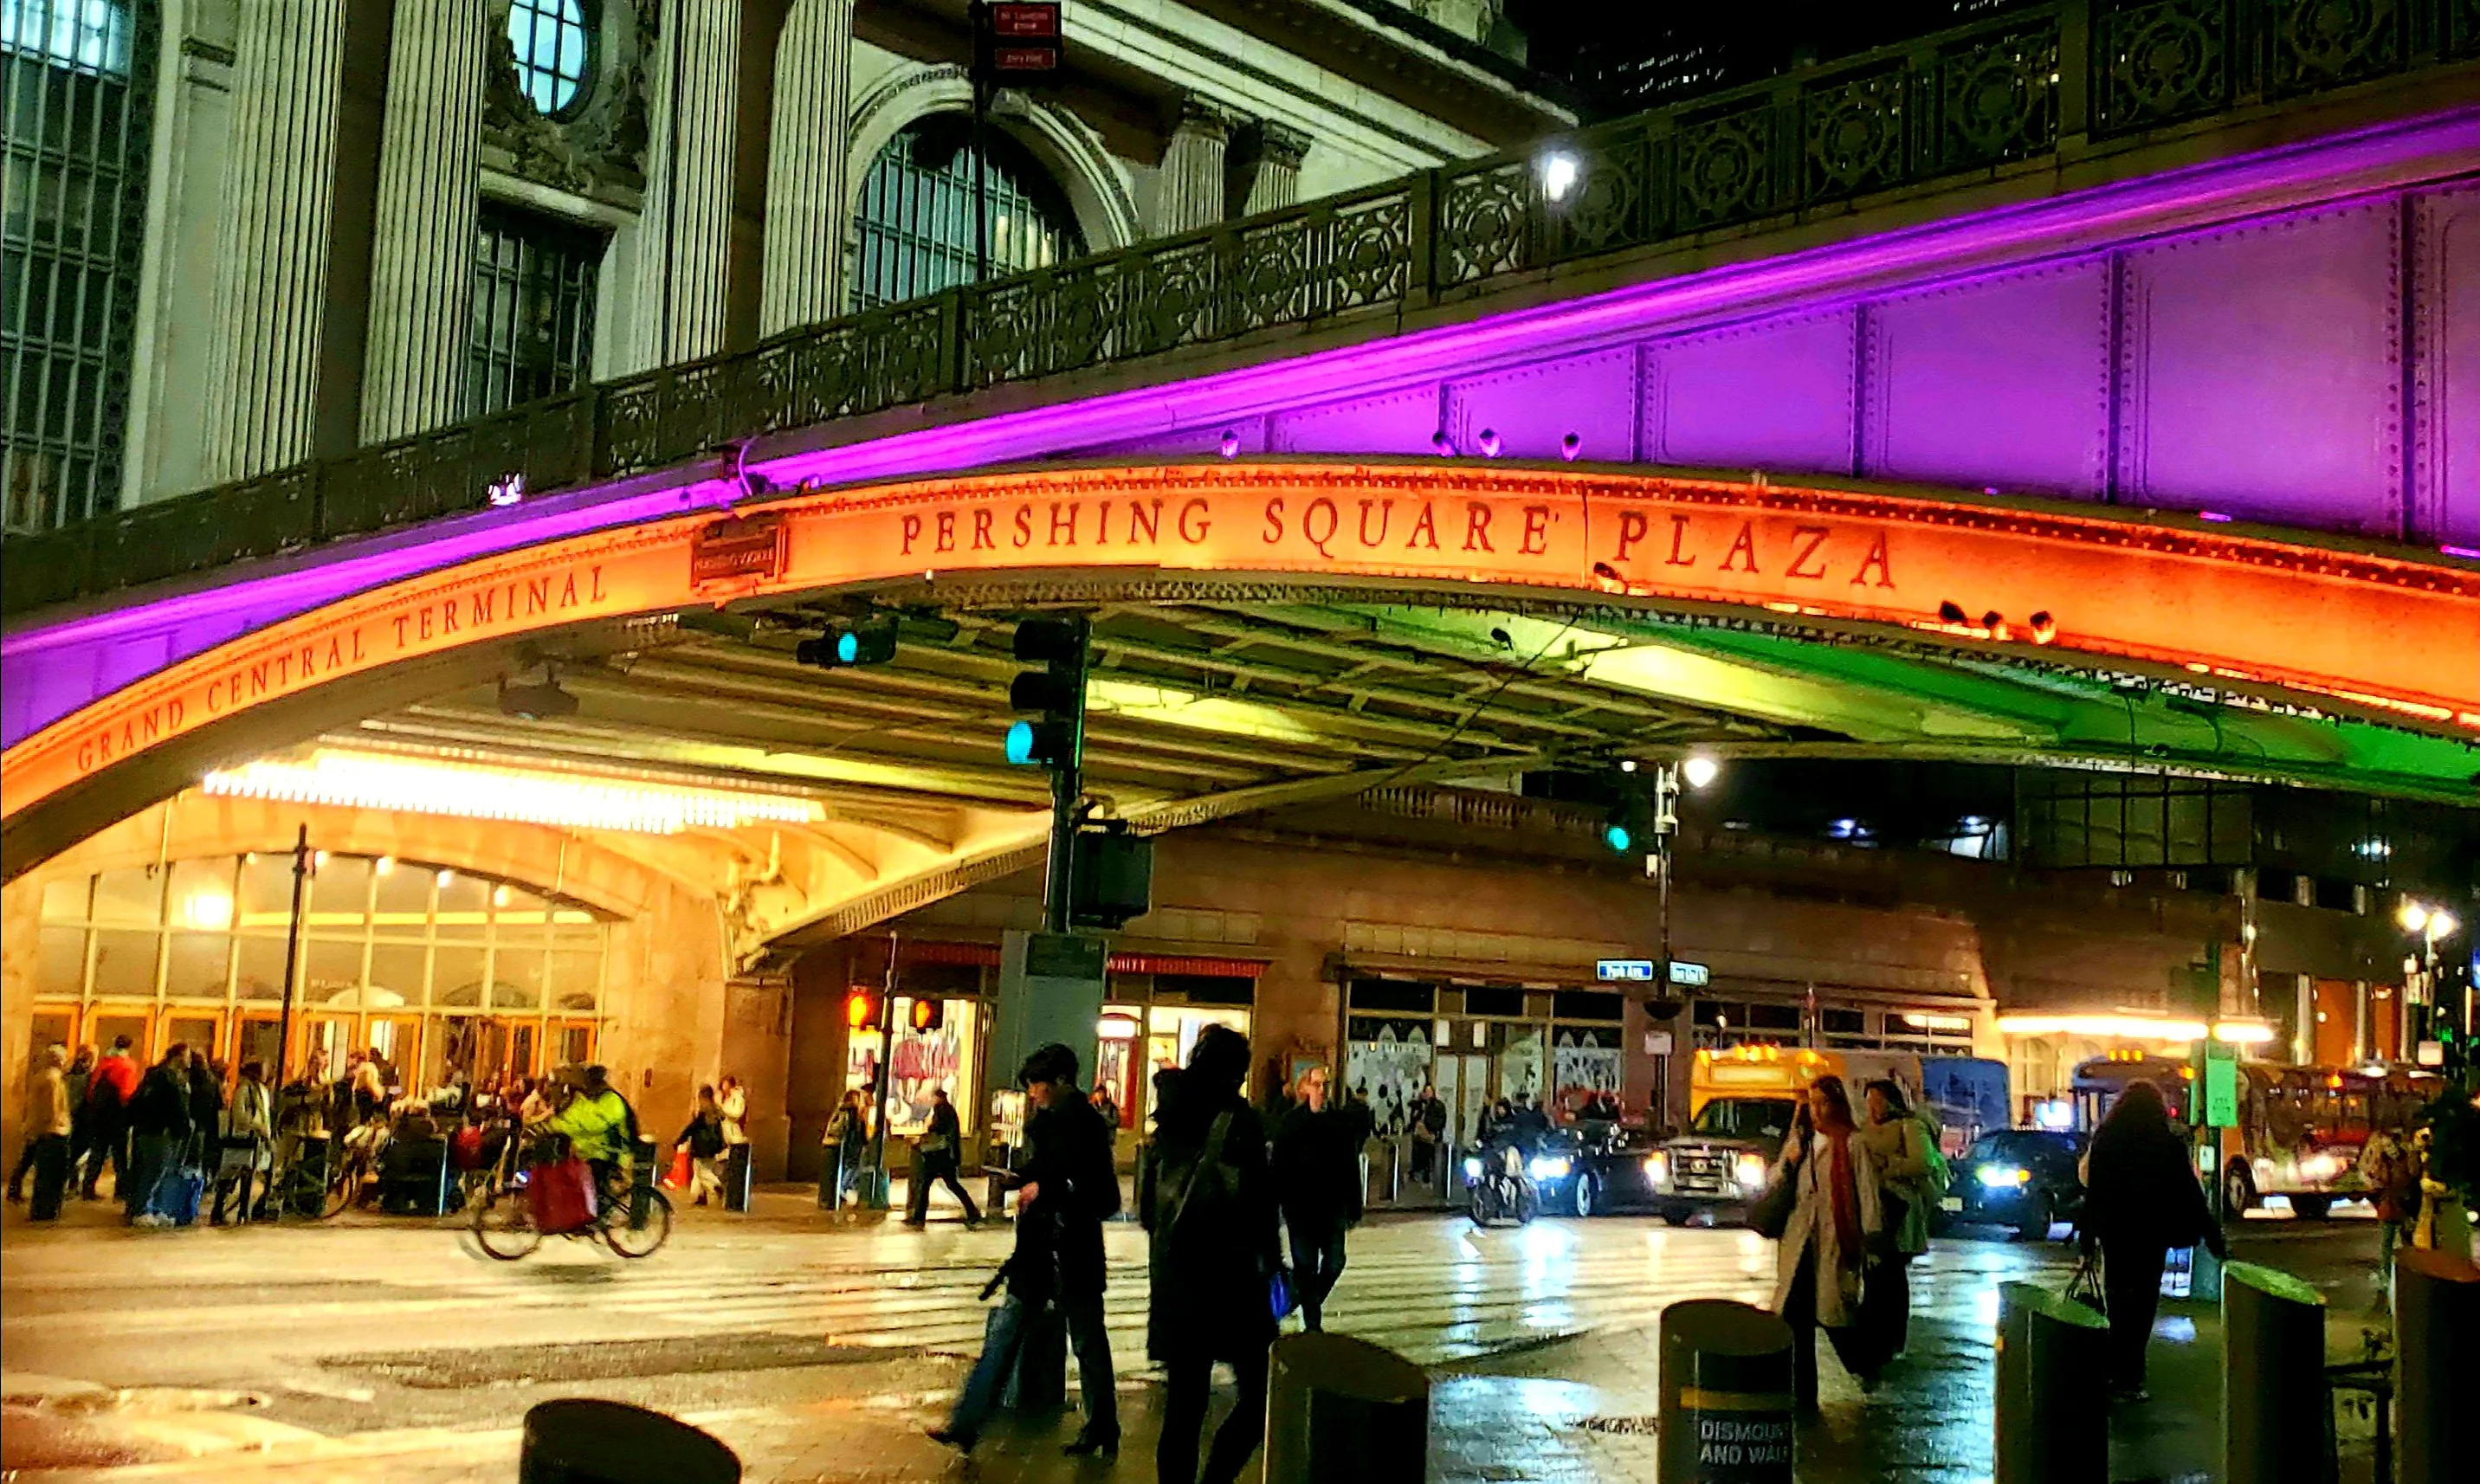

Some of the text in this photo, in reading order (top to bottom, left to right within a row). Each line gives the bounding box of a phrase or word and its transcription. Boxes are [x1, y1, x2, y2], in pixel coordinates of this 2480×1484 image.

[901, 497, 1896, 590] PERSHING SQUARE PLAZA
[77, 565, 605, 771] GRAND CENTRAL TERMINAL
[1700, 1442, 1742, 1465] AND
